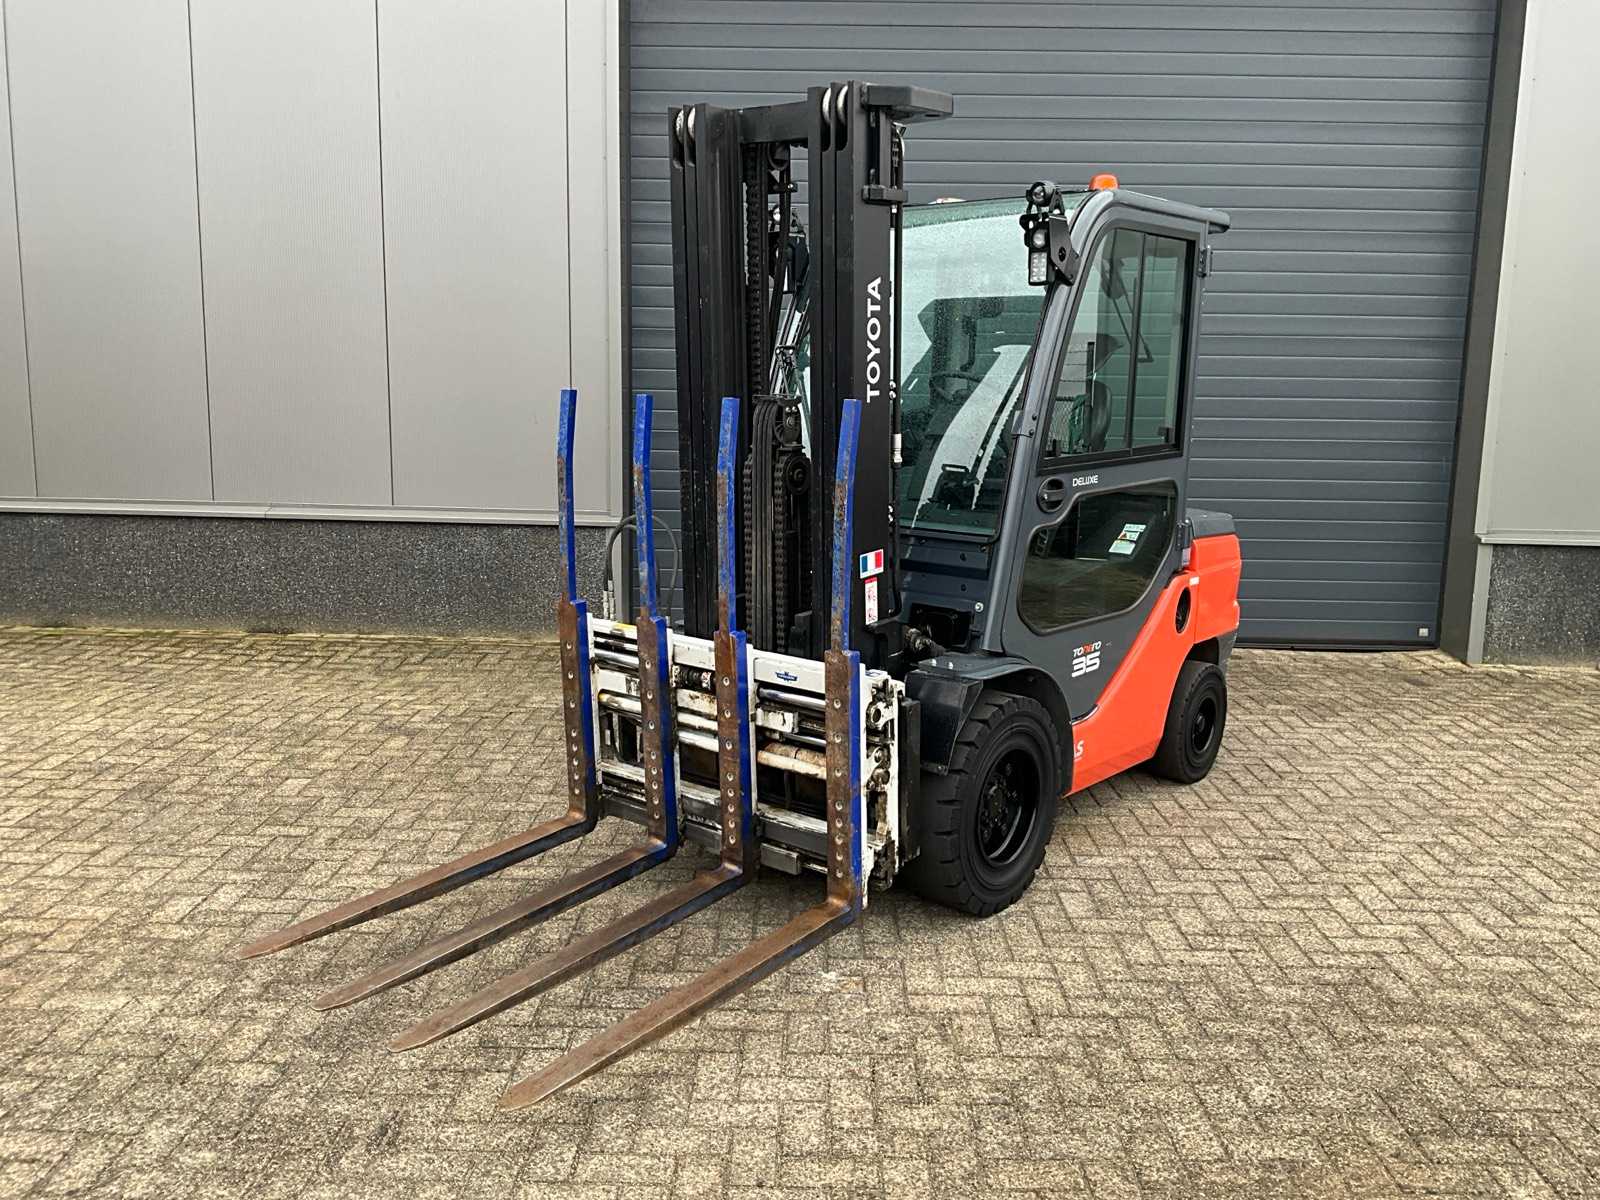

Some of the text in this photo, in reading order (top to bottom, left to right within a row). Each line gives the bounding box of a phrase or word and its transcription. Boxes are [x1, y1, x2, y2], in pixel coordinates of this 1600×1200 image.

[866, 276, 882, 403] TOYOTA
[1072, 474, 1099, 487] DELUXE
[1071, 650, 1101, 678] 35
